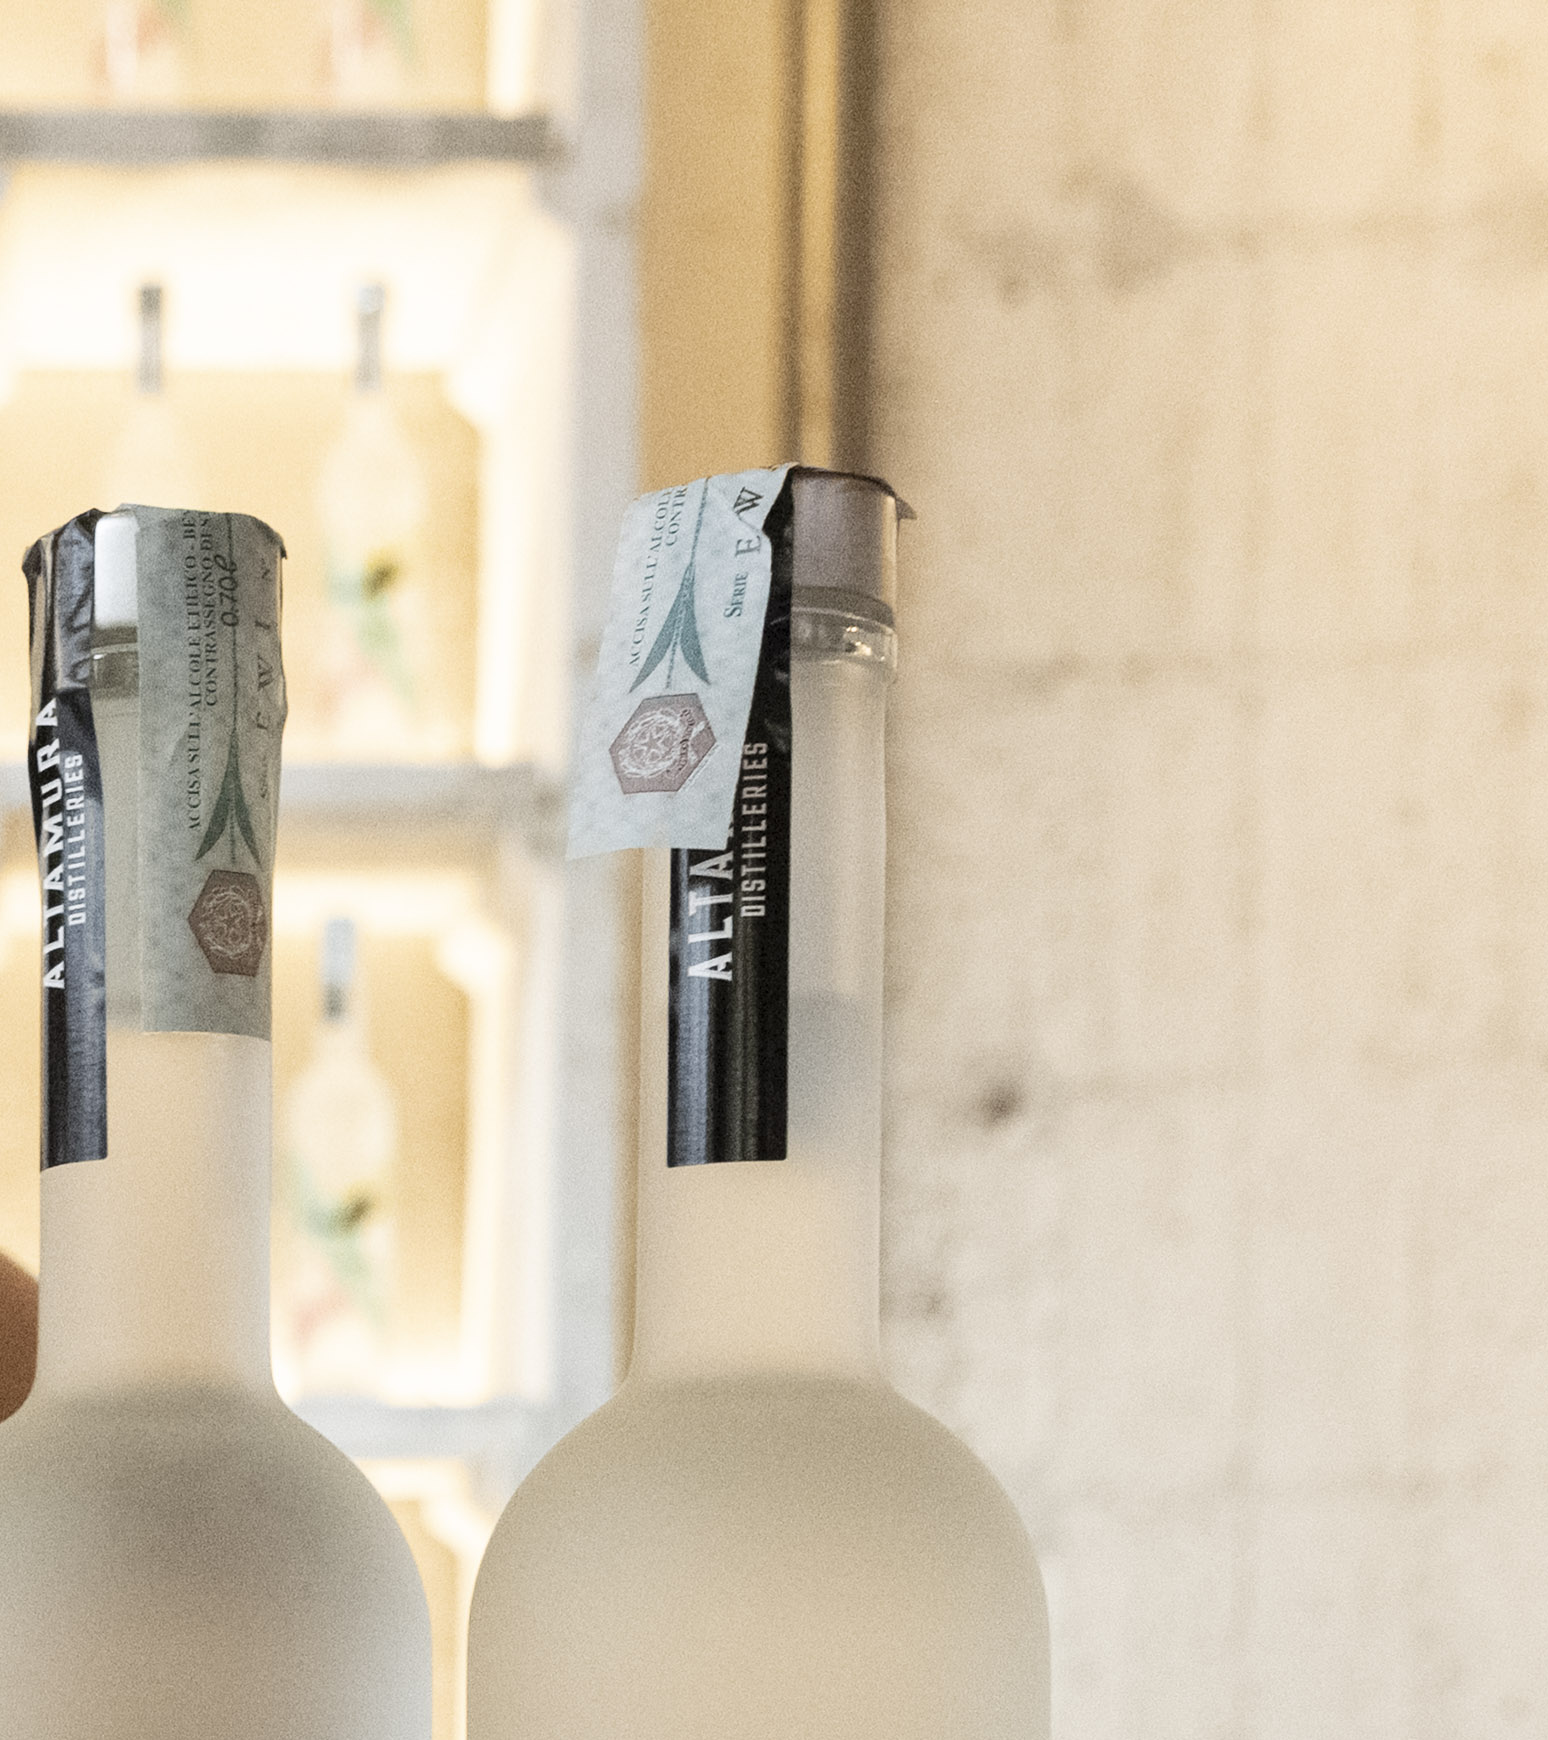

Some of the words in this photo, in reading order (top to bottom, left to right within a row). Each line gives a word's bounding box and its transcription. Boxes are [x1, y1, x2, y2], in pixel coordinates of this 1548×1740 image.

[733, 486, 764, 515] W
[201, 534, 213, 551] DI
[734, 535, 761, 558] E
[184, 556, 200, 631] ETILICO
[723, 572, 749, 618] SERIE
[202, 557, 217, 706] CONTRASSEGNO
[629, 605, 650, 666] ACCISA
[187, 768, 201, 829] ACCISA
[740, 741, 768, 918] DISTILLERIES
[35, 698, 66, 989] ALTAMURA
[65, 753, 87, 926] DISTILLERIES
[688, 815, 733, 981] ALTA
